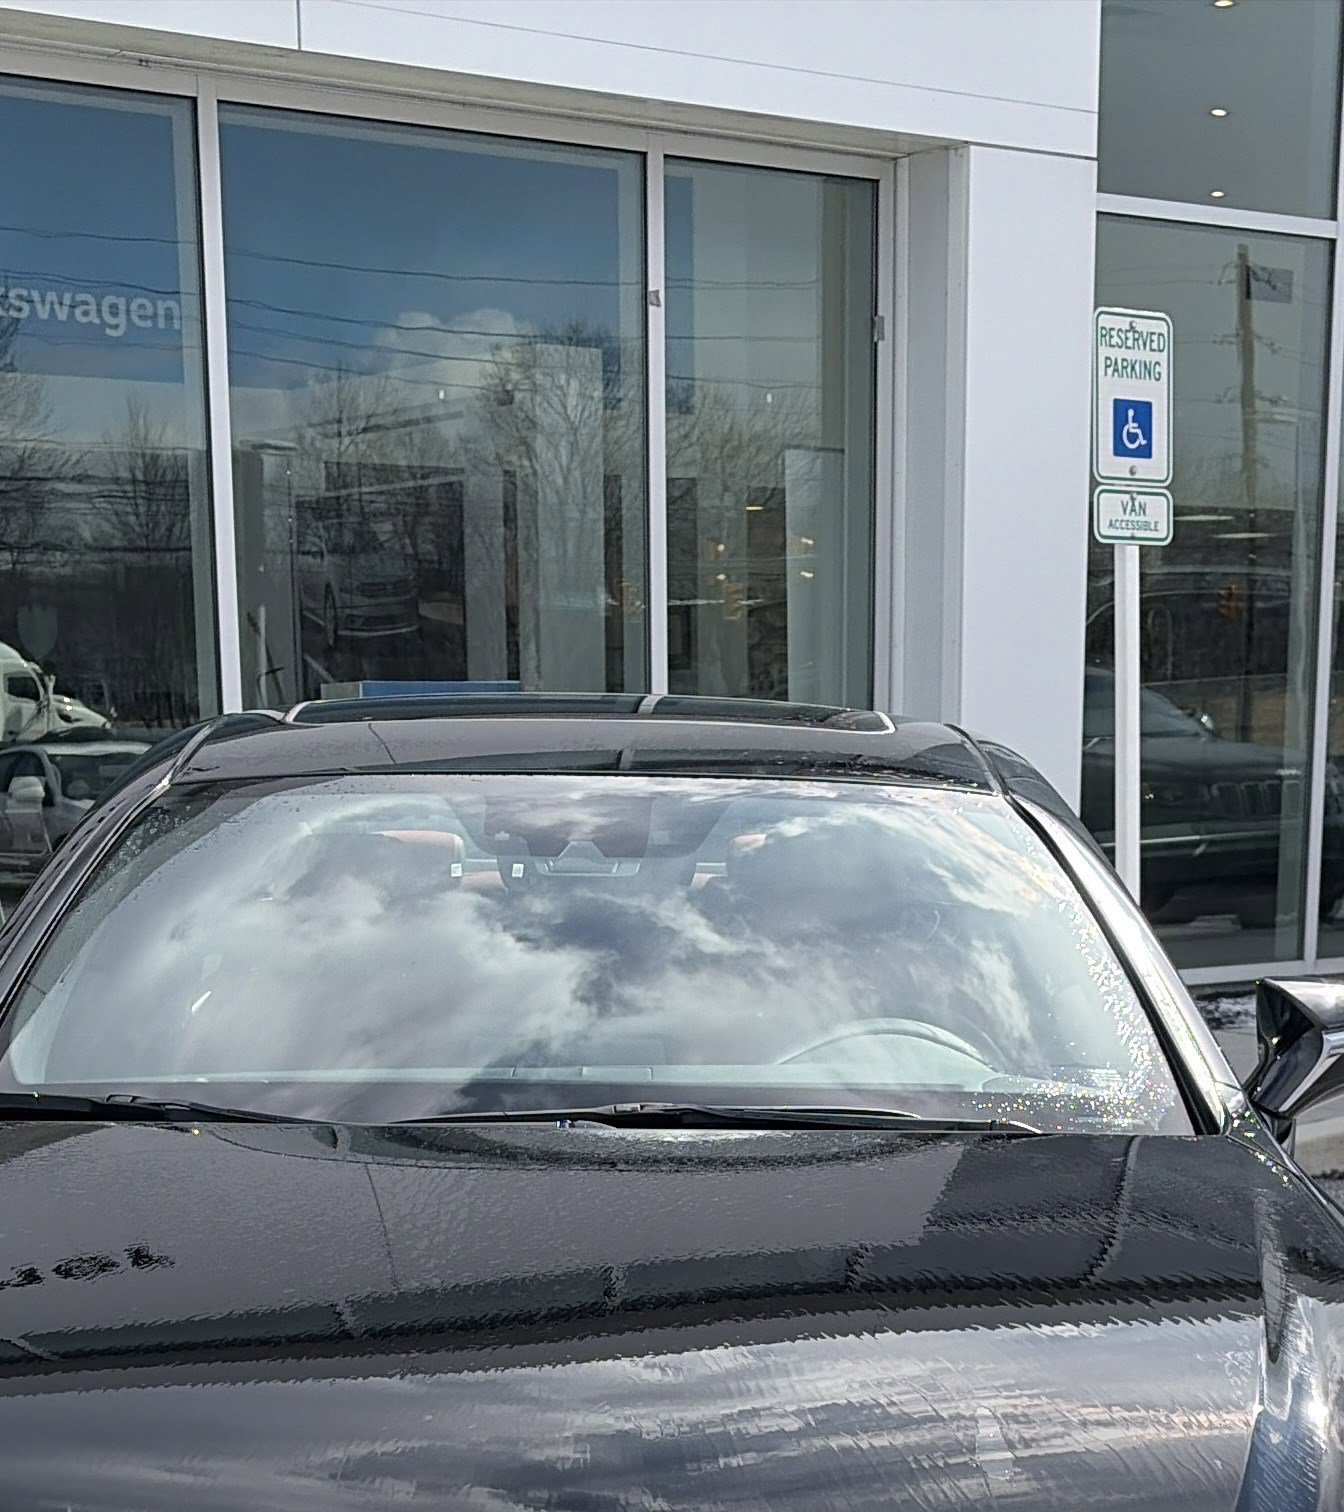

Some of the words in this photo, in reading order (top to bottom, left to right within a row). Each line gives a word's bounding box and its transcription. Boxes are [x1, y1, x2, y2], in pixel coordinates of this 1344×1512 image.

[1100, 326, 1166, 353] RESERVED
[1104, 356, 1162, 382] PARKING
[1121, 501, 1147, 517] VAN
[1108, 519, 1159, 532] ACCESSIBLE
